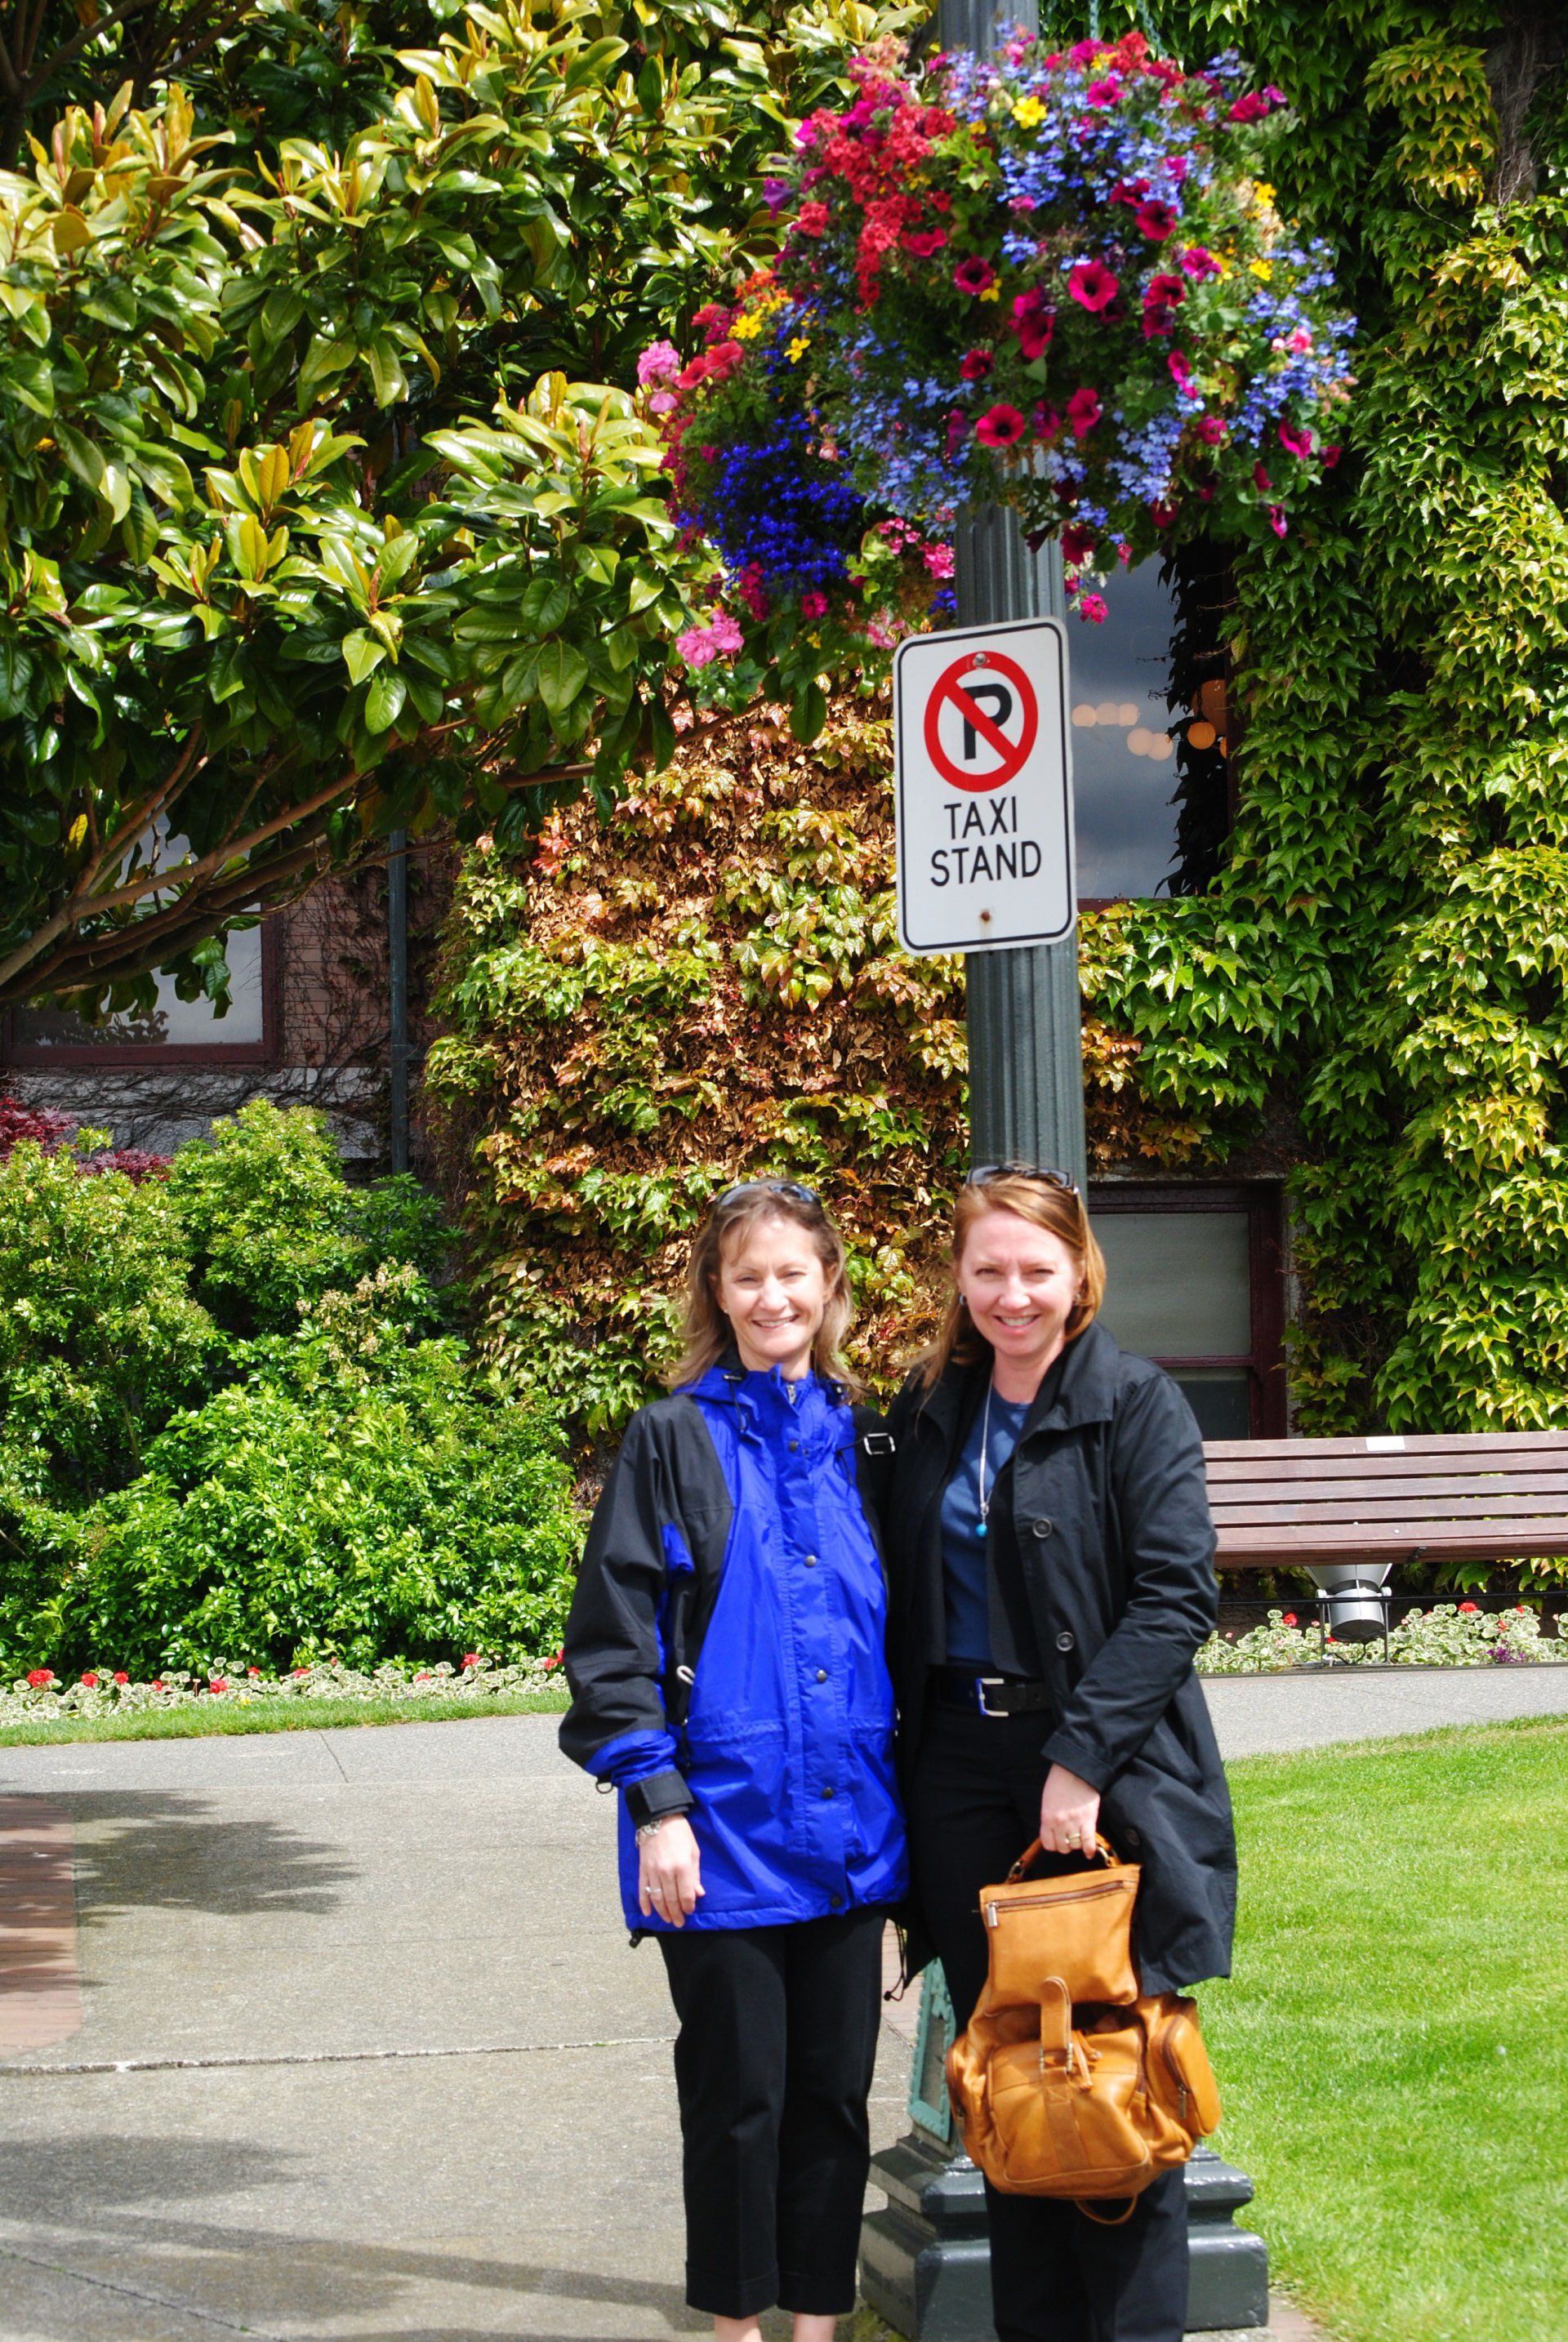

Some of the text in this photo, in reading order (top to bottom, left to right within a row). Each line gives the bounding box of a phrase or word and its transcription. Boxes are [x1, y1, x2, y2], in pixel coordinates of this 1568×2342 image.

[963, 683, 1013, 760] P
[943, 796, 1018, 840] TAXI
[930, 840, 1042, 887] STAND
